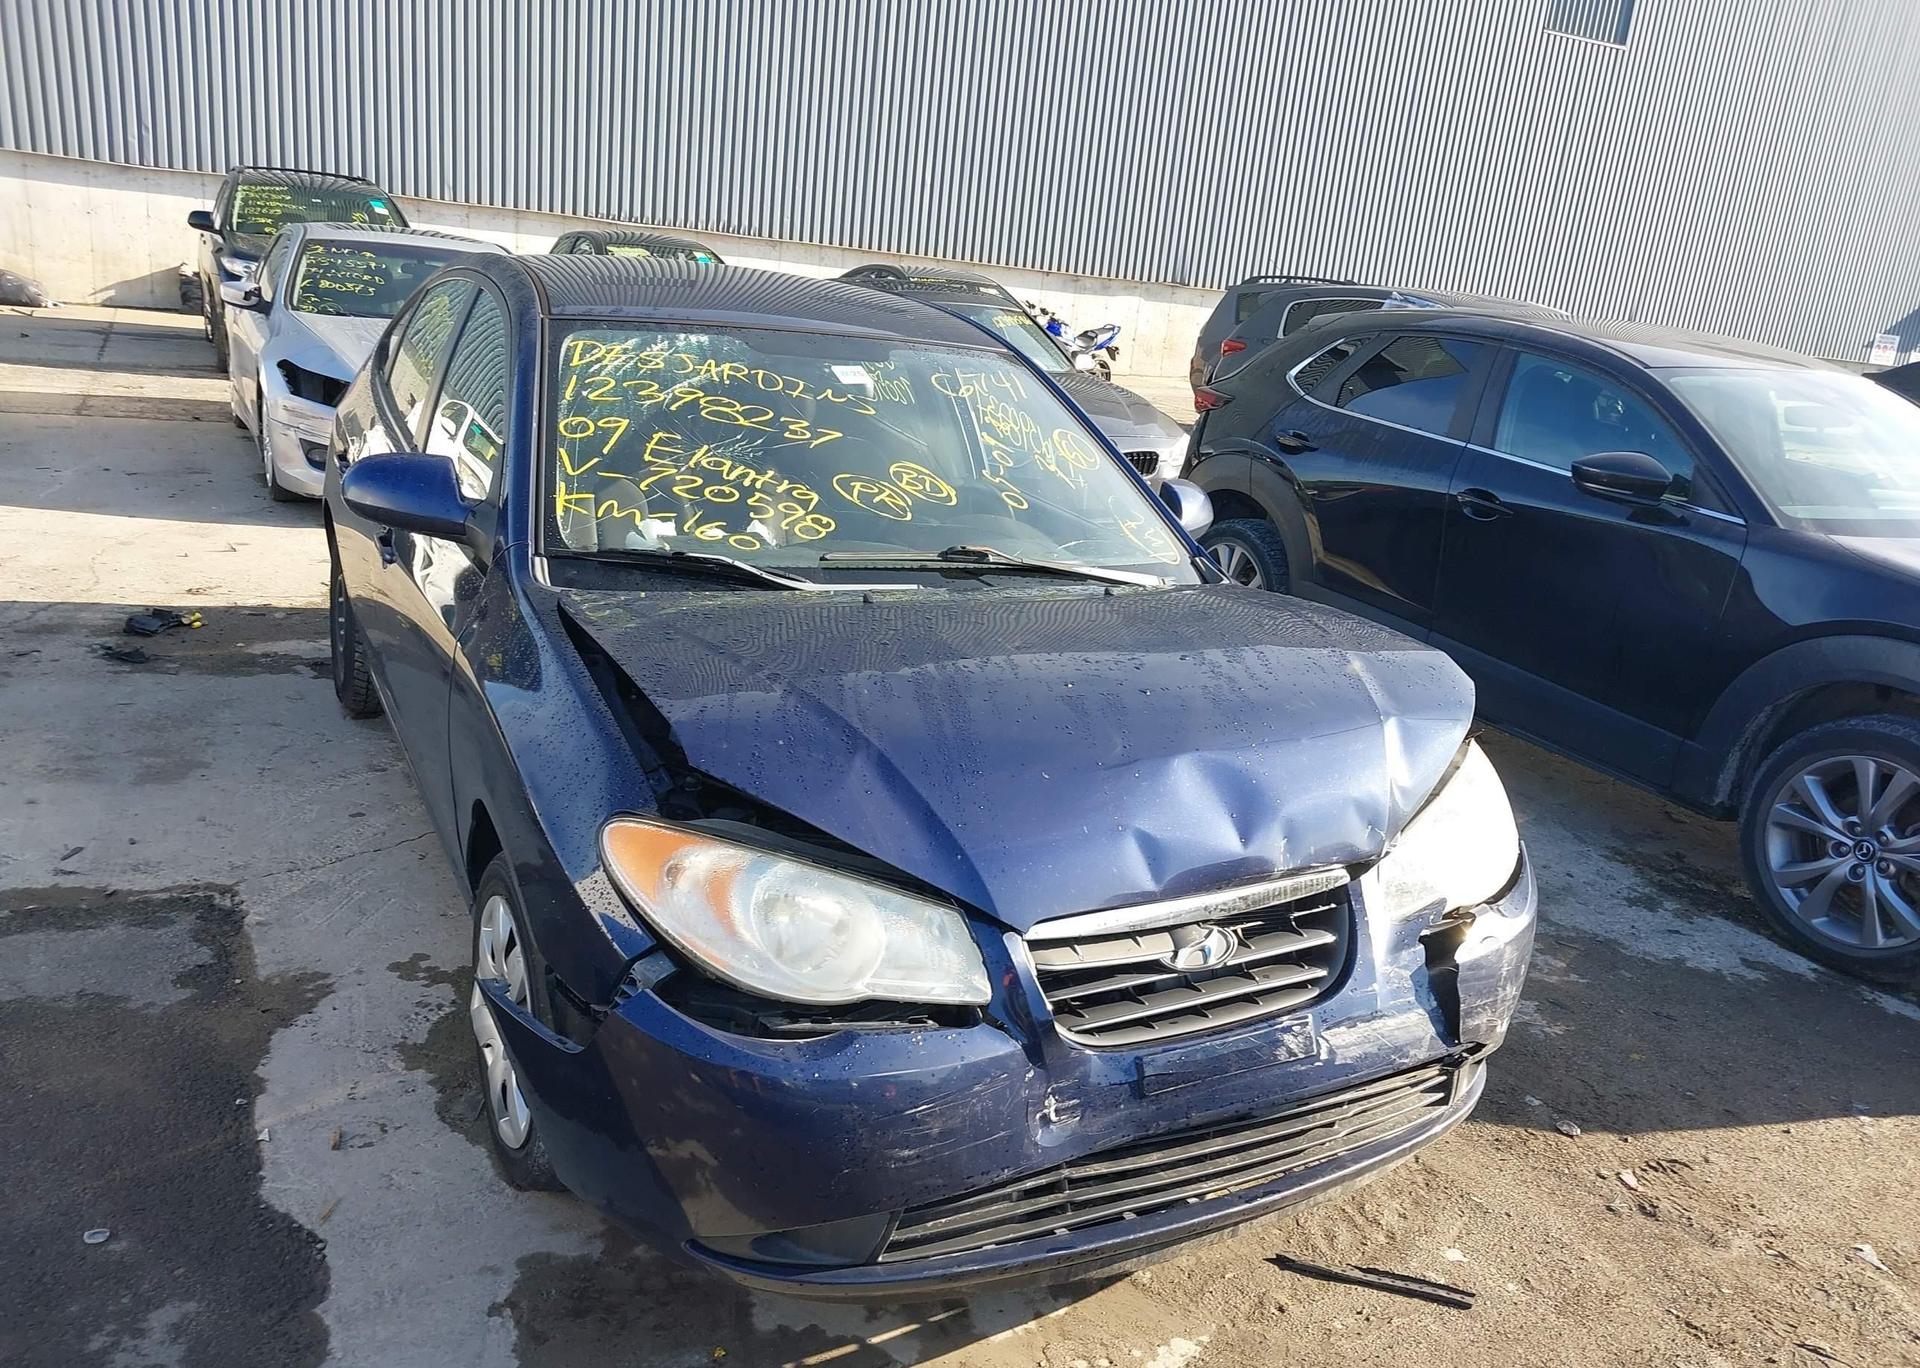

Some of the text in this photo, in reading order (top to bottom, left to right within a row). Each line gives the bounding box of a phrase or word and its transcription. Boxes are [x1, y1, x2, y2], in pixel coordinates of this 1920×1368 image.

[564, 374, 844, 449] 12398237
[569, 340, 876, 415] DESJARDINS
[559, 416, 630, 454] 09
